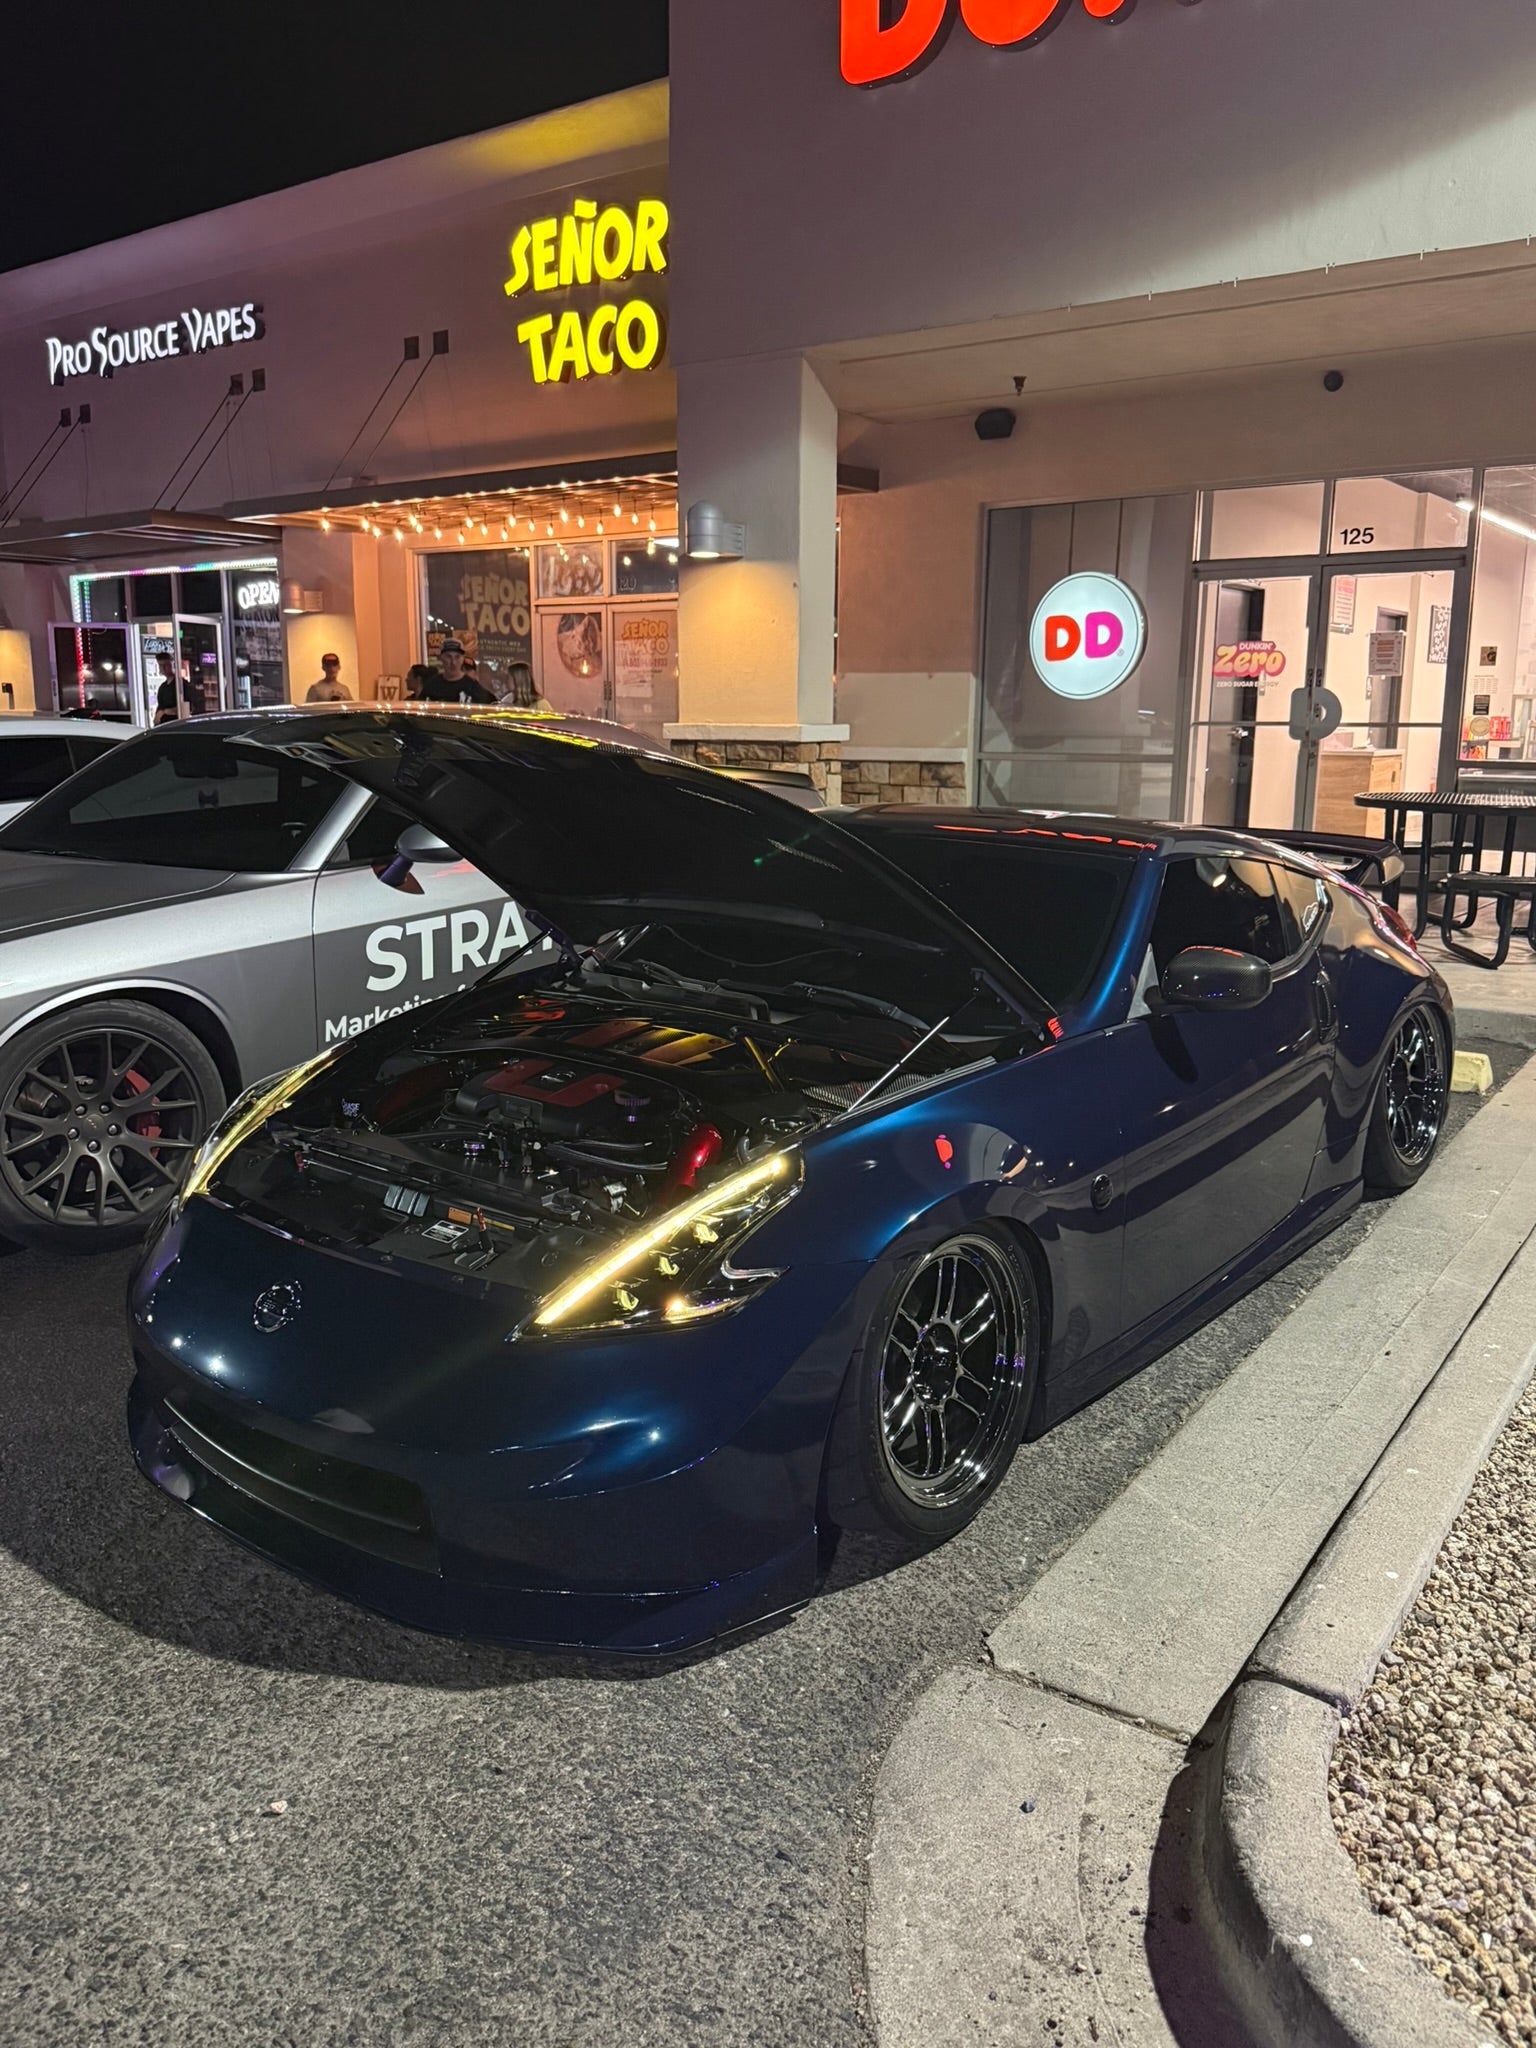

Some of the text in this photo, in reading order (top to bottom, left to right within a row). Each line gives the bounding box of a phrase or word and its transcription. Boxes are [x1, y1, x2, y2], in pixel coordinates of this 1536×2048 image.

[504, 199, 669, 296] SEÑOR
[91, 321, 180, 377] SOURCE
[181, 303, 257, 353] VAPES
[517, 300, 659, 384] TACO
[1340, 527, 1375, 545] 125
[238, 580, 280, 610] OPEN
[462, 572, 529, 606] SEÑOR
[463, 600, 530, 636] TACO
[622, 617, 669, 640] SEÑOR
[1045, 611, 1123, 661] DD
[1214, 645, 1284, 676] Zero
[366, 901, 553, 991] STRA
